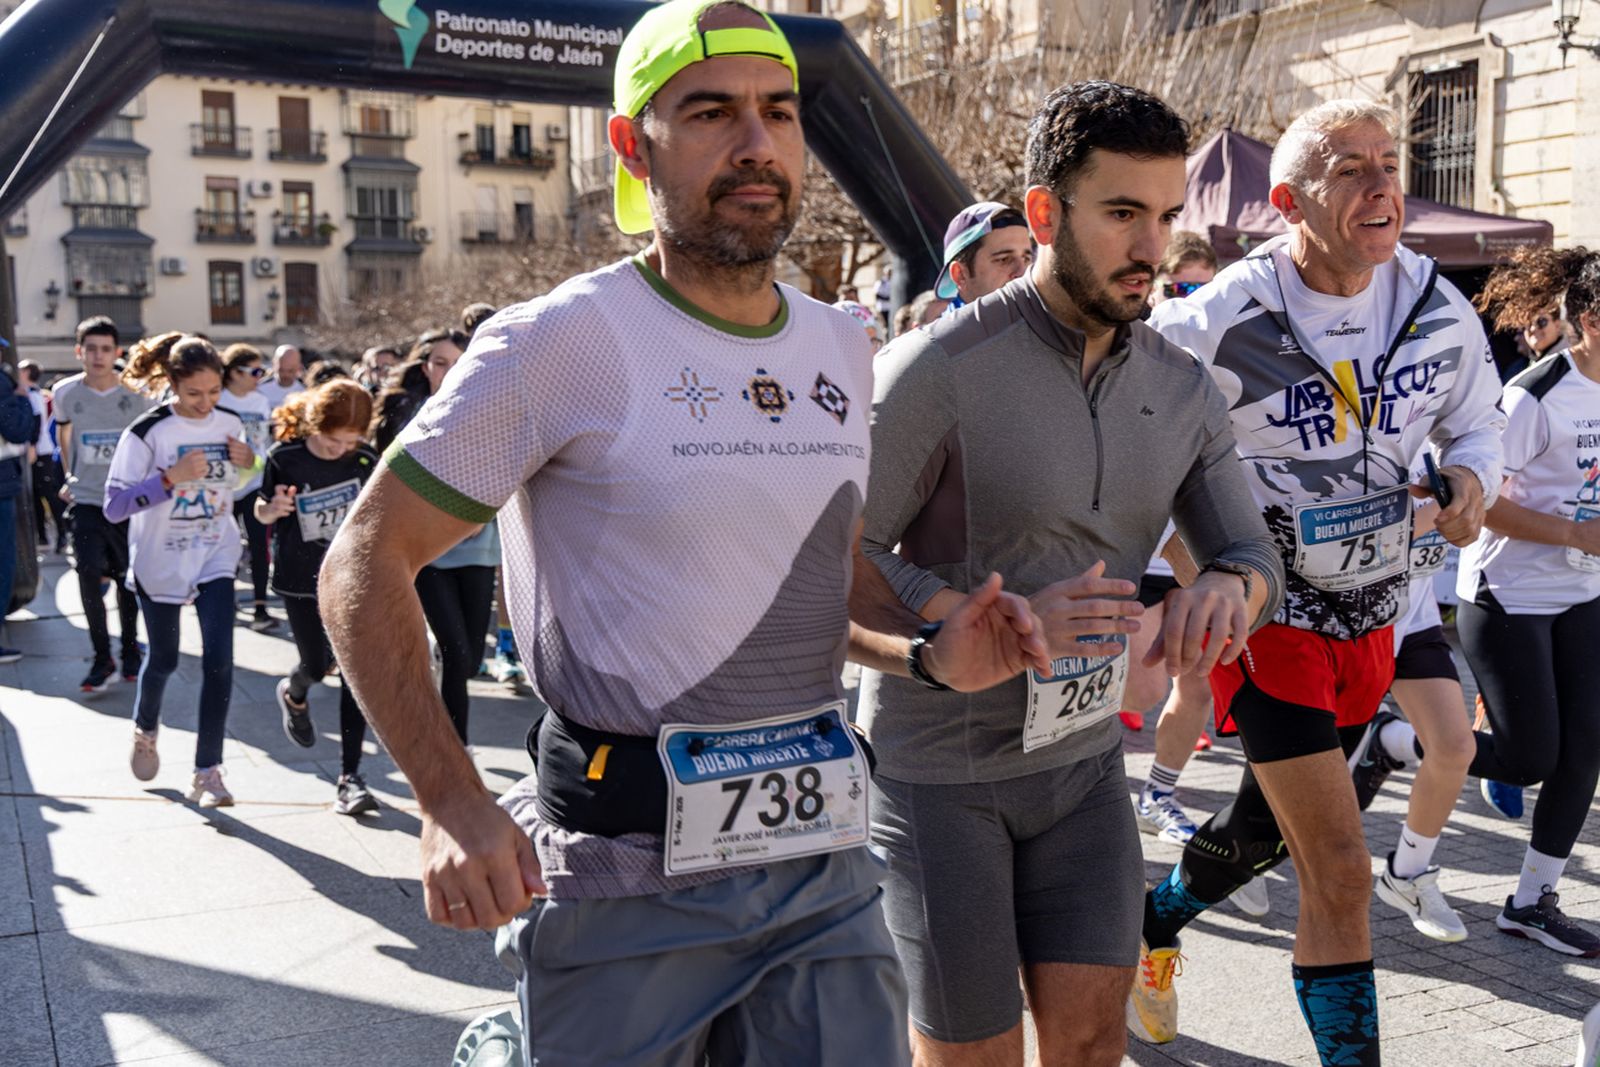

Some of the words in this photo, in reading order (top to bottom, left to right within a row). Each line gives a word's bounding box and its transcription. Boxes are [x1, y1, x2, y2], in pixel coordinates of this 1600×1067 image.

[436, 10, 530, 37] Patronato
[533, 19, 623, 47] Municipal
[435, 34, 524, 59] Deportes
[529, 42, 553, 62] de
[558, 44, 604, 66] Jaén
[673, 440, 764, 457] NOVOJAÉN
[769, 442, 865, 460] ALOJAMIENTOS
[1314, 513, 1323, 521] VI
[1324, 506, 1362, 520] CARRERA
[1363, 495, 1398, 512] CAMINATA
[1315, 521, 1347, 540] BUENA
[1349, 512, 1382, 533] MUERTE
[1340, 533, 1376, 571] 75
[1056, 664, 1113, 718] 269
[691, 752, 748, 775] BUENA
[748, 743, 810, 766] MUERTE
[719, 766, 825, 832] 738
[712, 834, 741, 845] JAVIER
